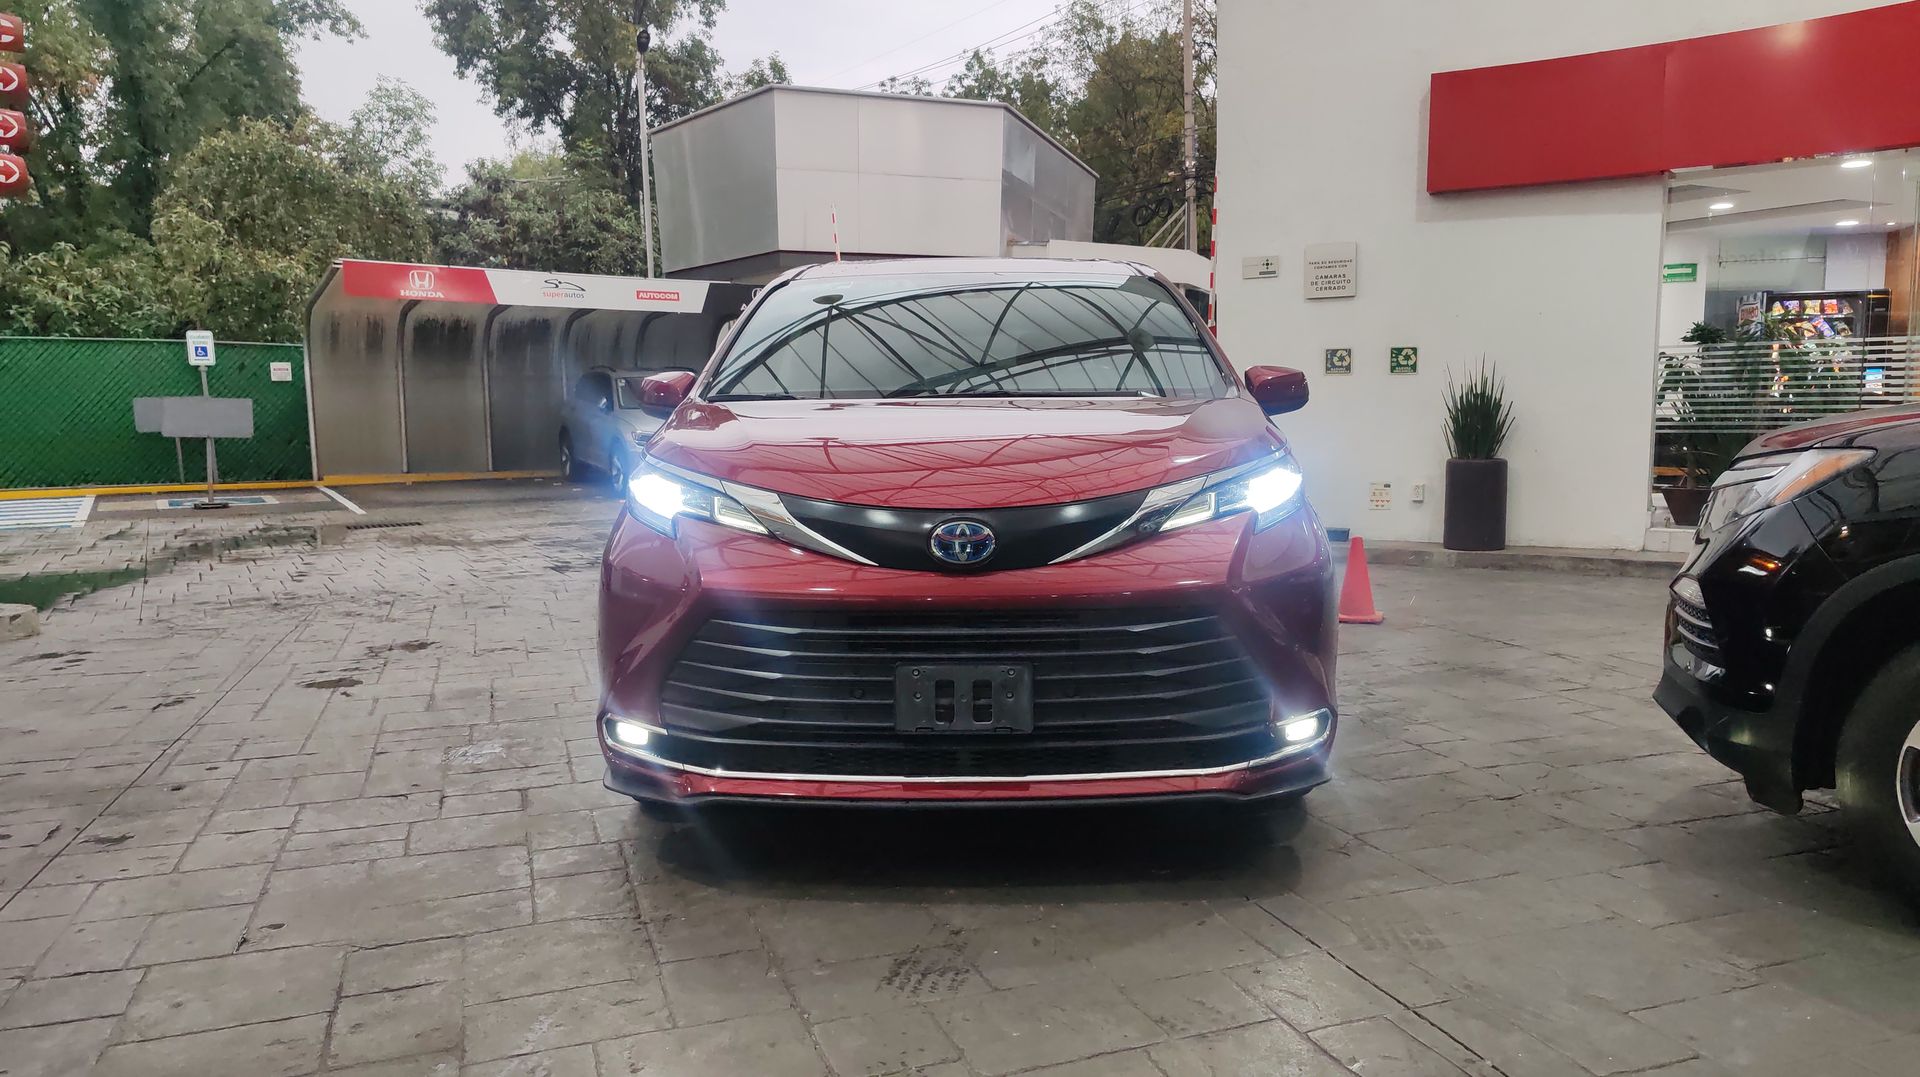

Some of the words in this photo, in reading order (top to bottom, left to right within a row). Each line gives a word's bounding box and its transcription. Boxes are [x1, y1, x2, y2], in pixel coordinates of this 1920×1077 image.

[400, 289, 445, 298] HONDA
[543, 290, 585, 299] superautos
[639, 292, 679, 300] AUTOCOM
